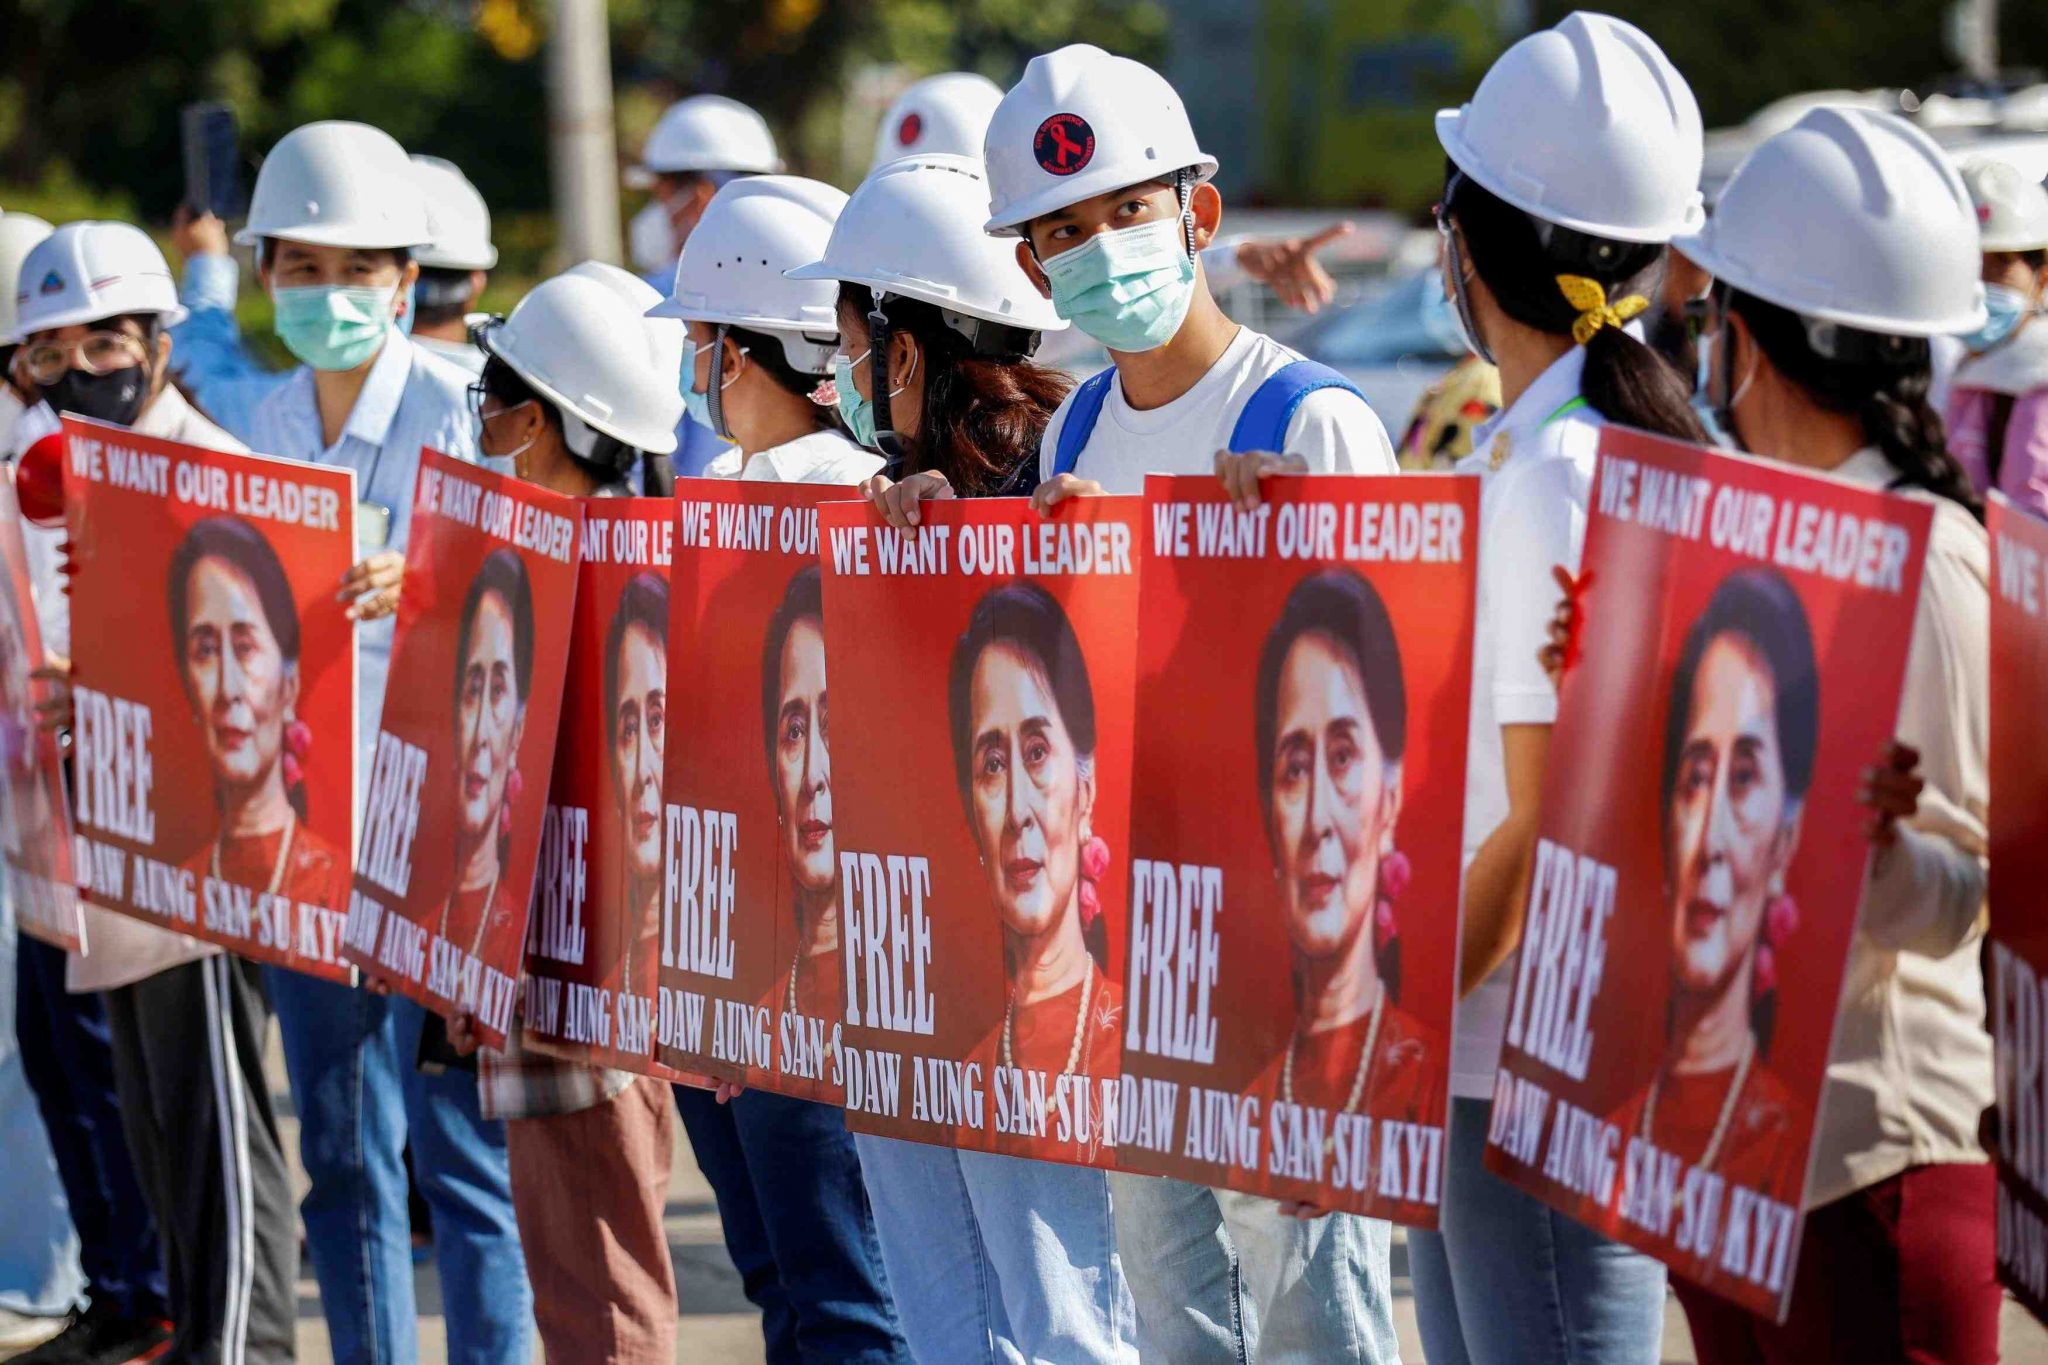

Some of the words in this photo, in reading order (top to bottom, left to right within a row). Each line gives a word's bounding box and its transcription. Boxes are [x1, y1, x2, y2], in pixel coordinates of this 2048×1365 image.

[69, 434, 103, 482] WE
[106, 442, 170, 497] WANT
[175, 461, 229, 511] OUR
[234, 472, 340, 531] LEADER
[420, 465, 443, 511] WE
[441, 473, 482, 527] WANT
[481, 490, 514, 541] OUR
[513, 501, 574, 564] LEADER
[682, 500, 711, 548] WE
[716, 502, 773, 551] WANT
[1153, 502, 1190, 557] WE
[1196, 503, 1271, 558] WANT
[1276, 502, 1337, 560] OUR
[1343, 502, 1464, 562] LEADER
[1599, 454, 1637, 522] WE
[1637, 463, 1712, 542] WANT
[1710, 485, 1774, 560] OUR
[1773, 500, 1910, 594] LEADER
[579, 518, 609, 562] ANT
[613, 519, 648, 565] OUR
[829, 526, 870, 576] WE
[875, 524, 950, 575] WANT
[958, 524, 1015, 576] OUR
[1022, 522, 1132, 576] LEADER
[1997, 530, 2038, 616] WE
[73, 684, 155, 845] FREE
[358, 729, 428, 898] FREE
[74, 834, 126, 901] DAW
[132, 854, 197, 924] AUNG
[202, 875, 252, 940] SAN
[257, 892, 291, 950] SU
[662, 803, 737, 980] FREE
[840, 851, 935, 1035] FREE
[345, 888, 384, 957] DAW
[379, 910, 428, 984] AUNG
[427, 934, 462, 1001] SAN
[479, 964, 516, 1036] KYI
[524, 972, 562, 1036] DAW
[564, 982, 611, 1047] AUNG
[616, 992, 652, 1056] SAN
[1126, 858, 1223, 1065] FREE
[1507, 838, 1618, 1082] FREE
[657, 986, 705, 1054] DAW
[712, 998, 771, 1070] AUNG
[780, 1011, 825, 1081] SAN
[845, 1046, 901, 1118] DAW
[912, 1056, 983, 1130] AUNG
[994, 1065, 1046, 1138] SAN
[1056, 1073, 1091, 1144] SU
[1119, 1074, 1178, 1153] DAW
[1184, 1086, 1260, 1171] AUNG
[1269, 1100, 1327, 1182] SAN
[1332, 1110, 1372, 1192] SU
[1377, 1118, 1443, 1205] KYI
[1488, 1066, 1551, 1168] DAW
[1543, 1099, 1621, 1208] AUNG
[1617, 1135, 1681, 1238] SAN
[1675, 1166, 1725, 1259] SU
[1720, 1184, 1796, 1295] KYI
